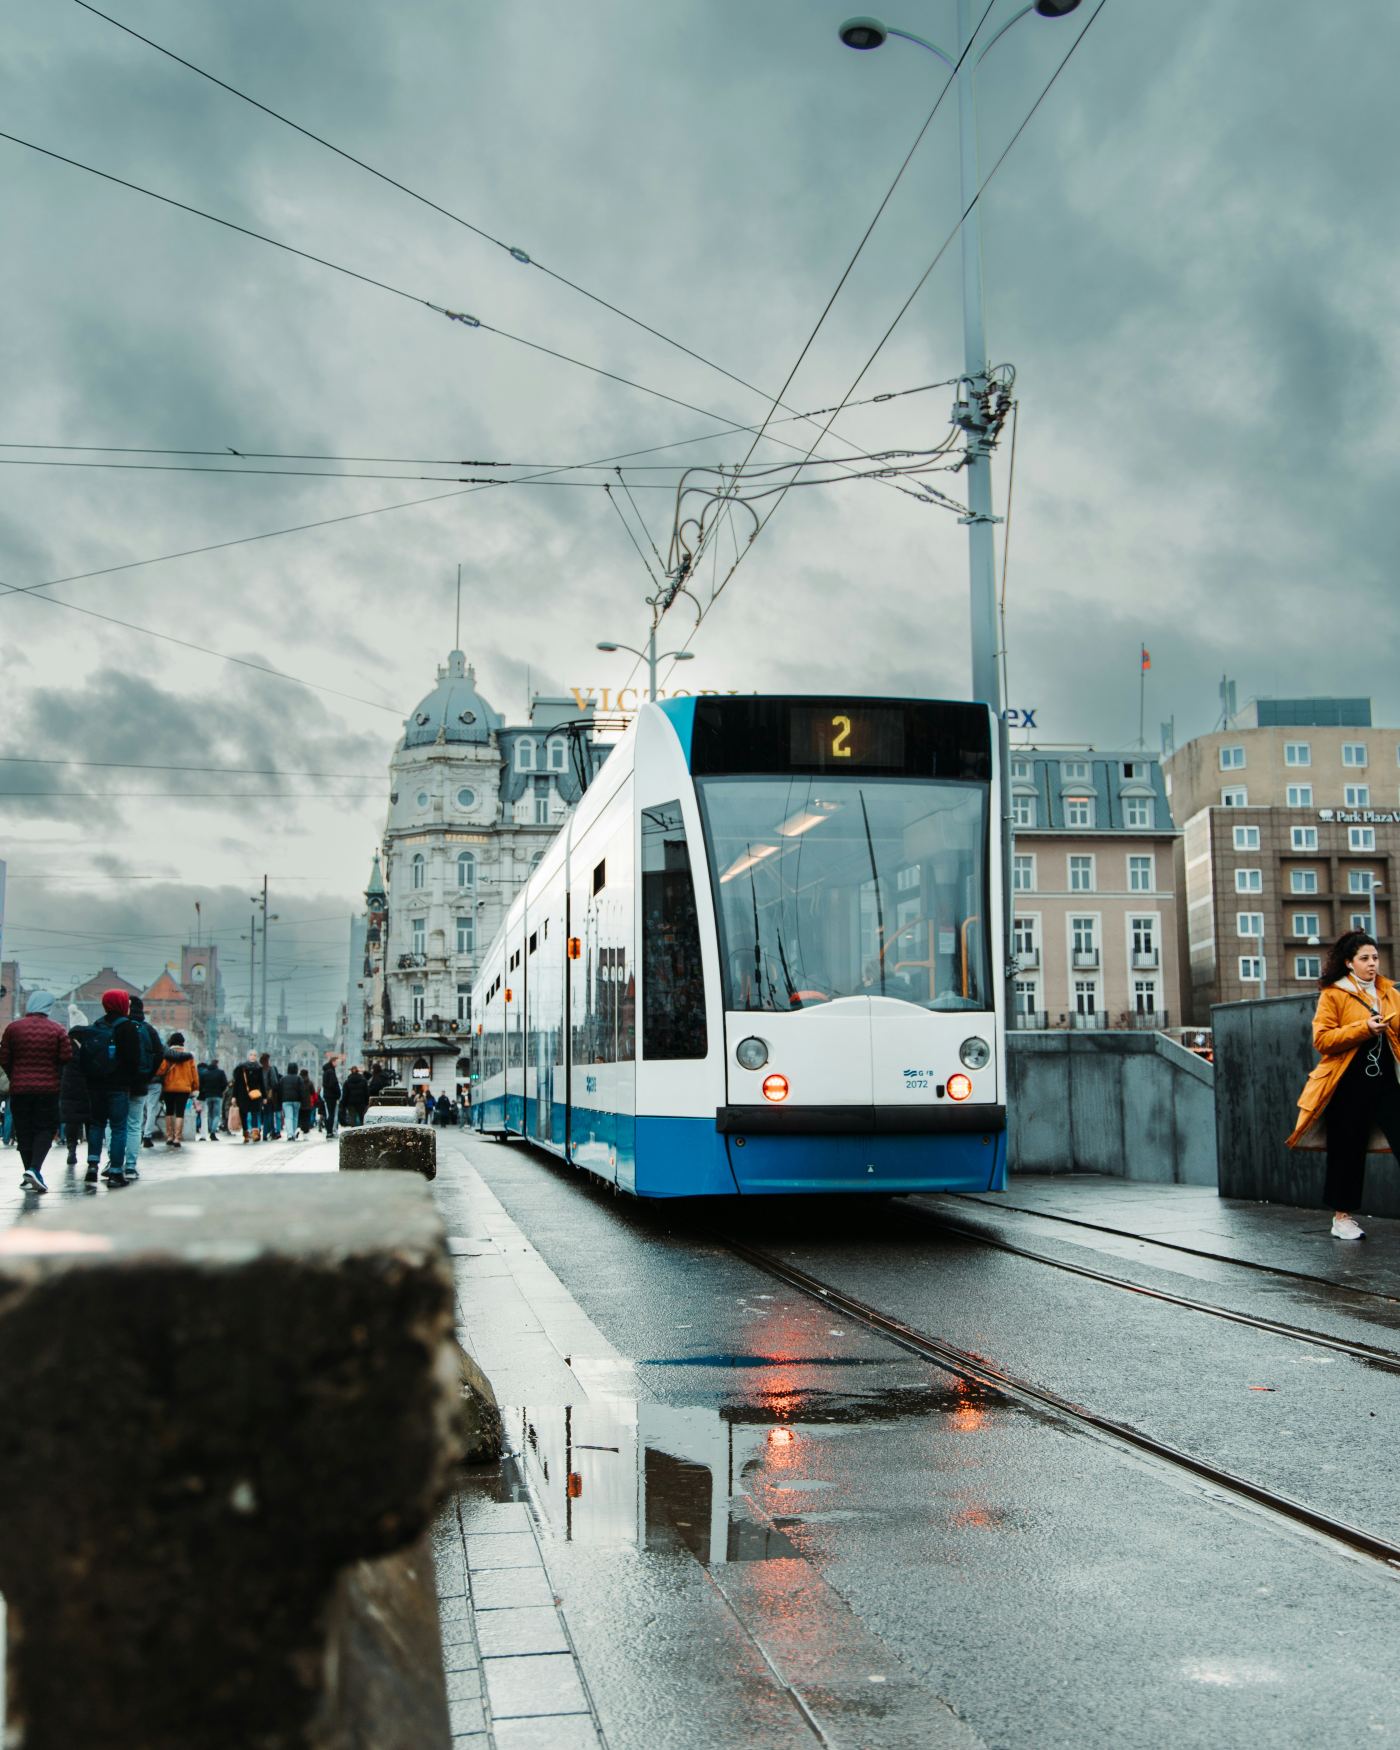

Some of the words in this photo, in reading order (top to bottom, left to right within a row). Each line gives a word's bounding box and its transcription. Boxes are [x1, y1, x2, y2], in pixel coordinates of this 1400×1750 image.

[570, 687, 758, 712] VICT
[832, 715, 851, 757] 2
[1336, 810, 1361, 823] Park
[1363, 810, 1392, 823] Plaza
[906, 1080, 928, 1089] 2072
